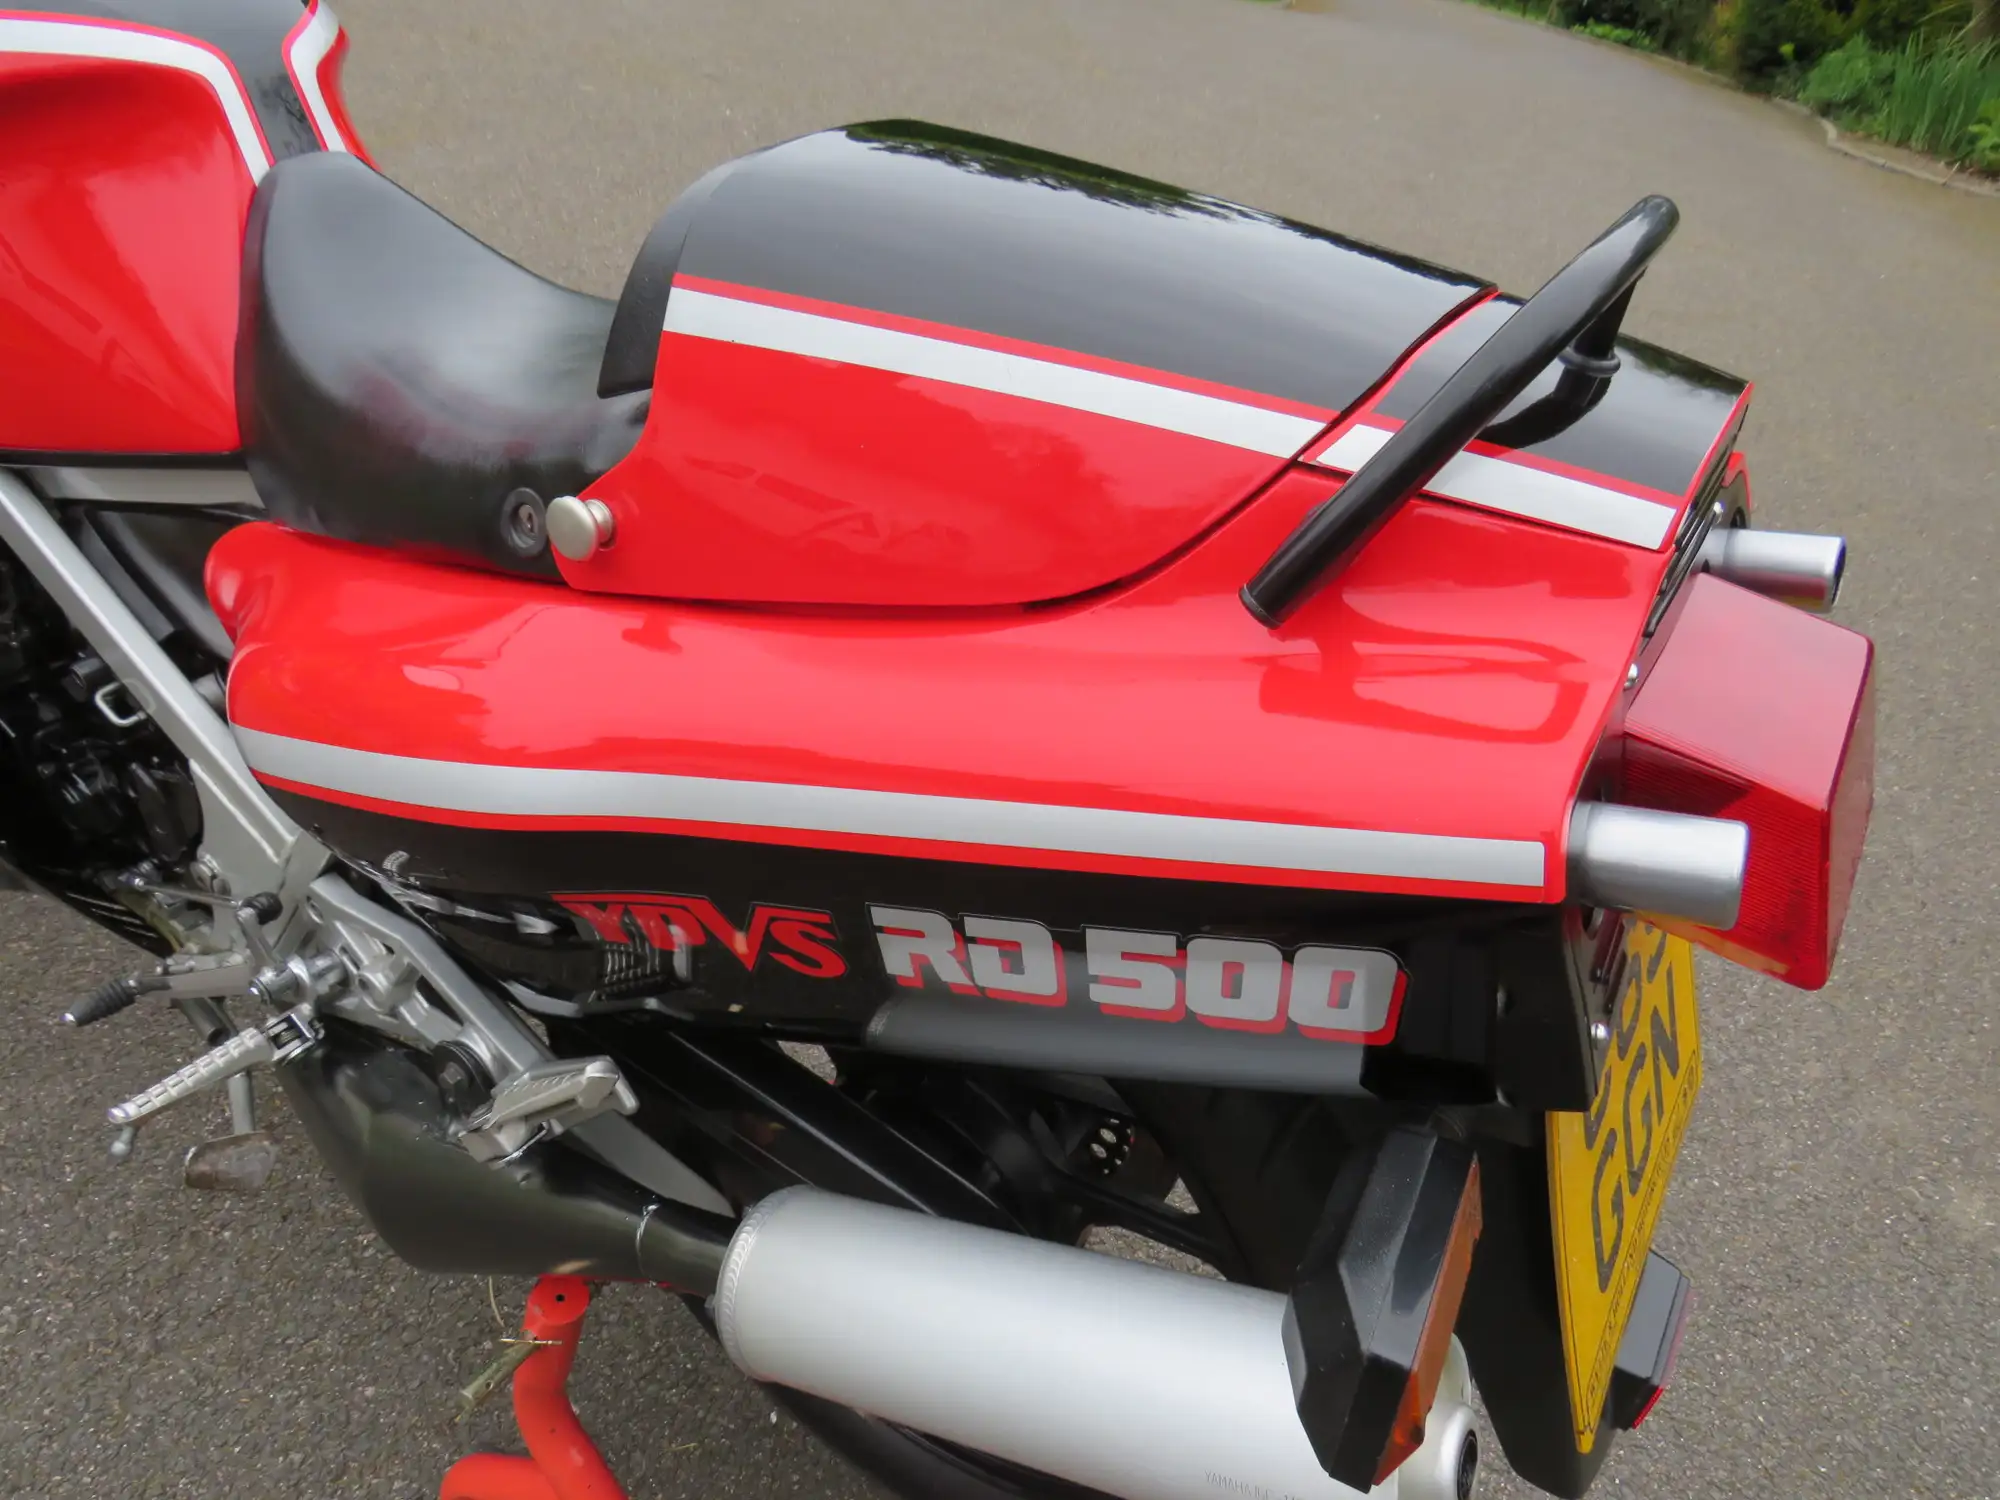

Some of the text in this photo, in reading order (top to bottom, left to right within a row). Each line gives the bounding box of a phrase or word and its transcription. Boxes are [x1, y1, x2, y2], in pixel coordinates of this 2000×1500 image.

[551, 893, 1408, 1046] YPVS RD 500
[1592, 960, 1680, 1293] GGN
[1204, 1469, 1252, 1498] YAMAHA
